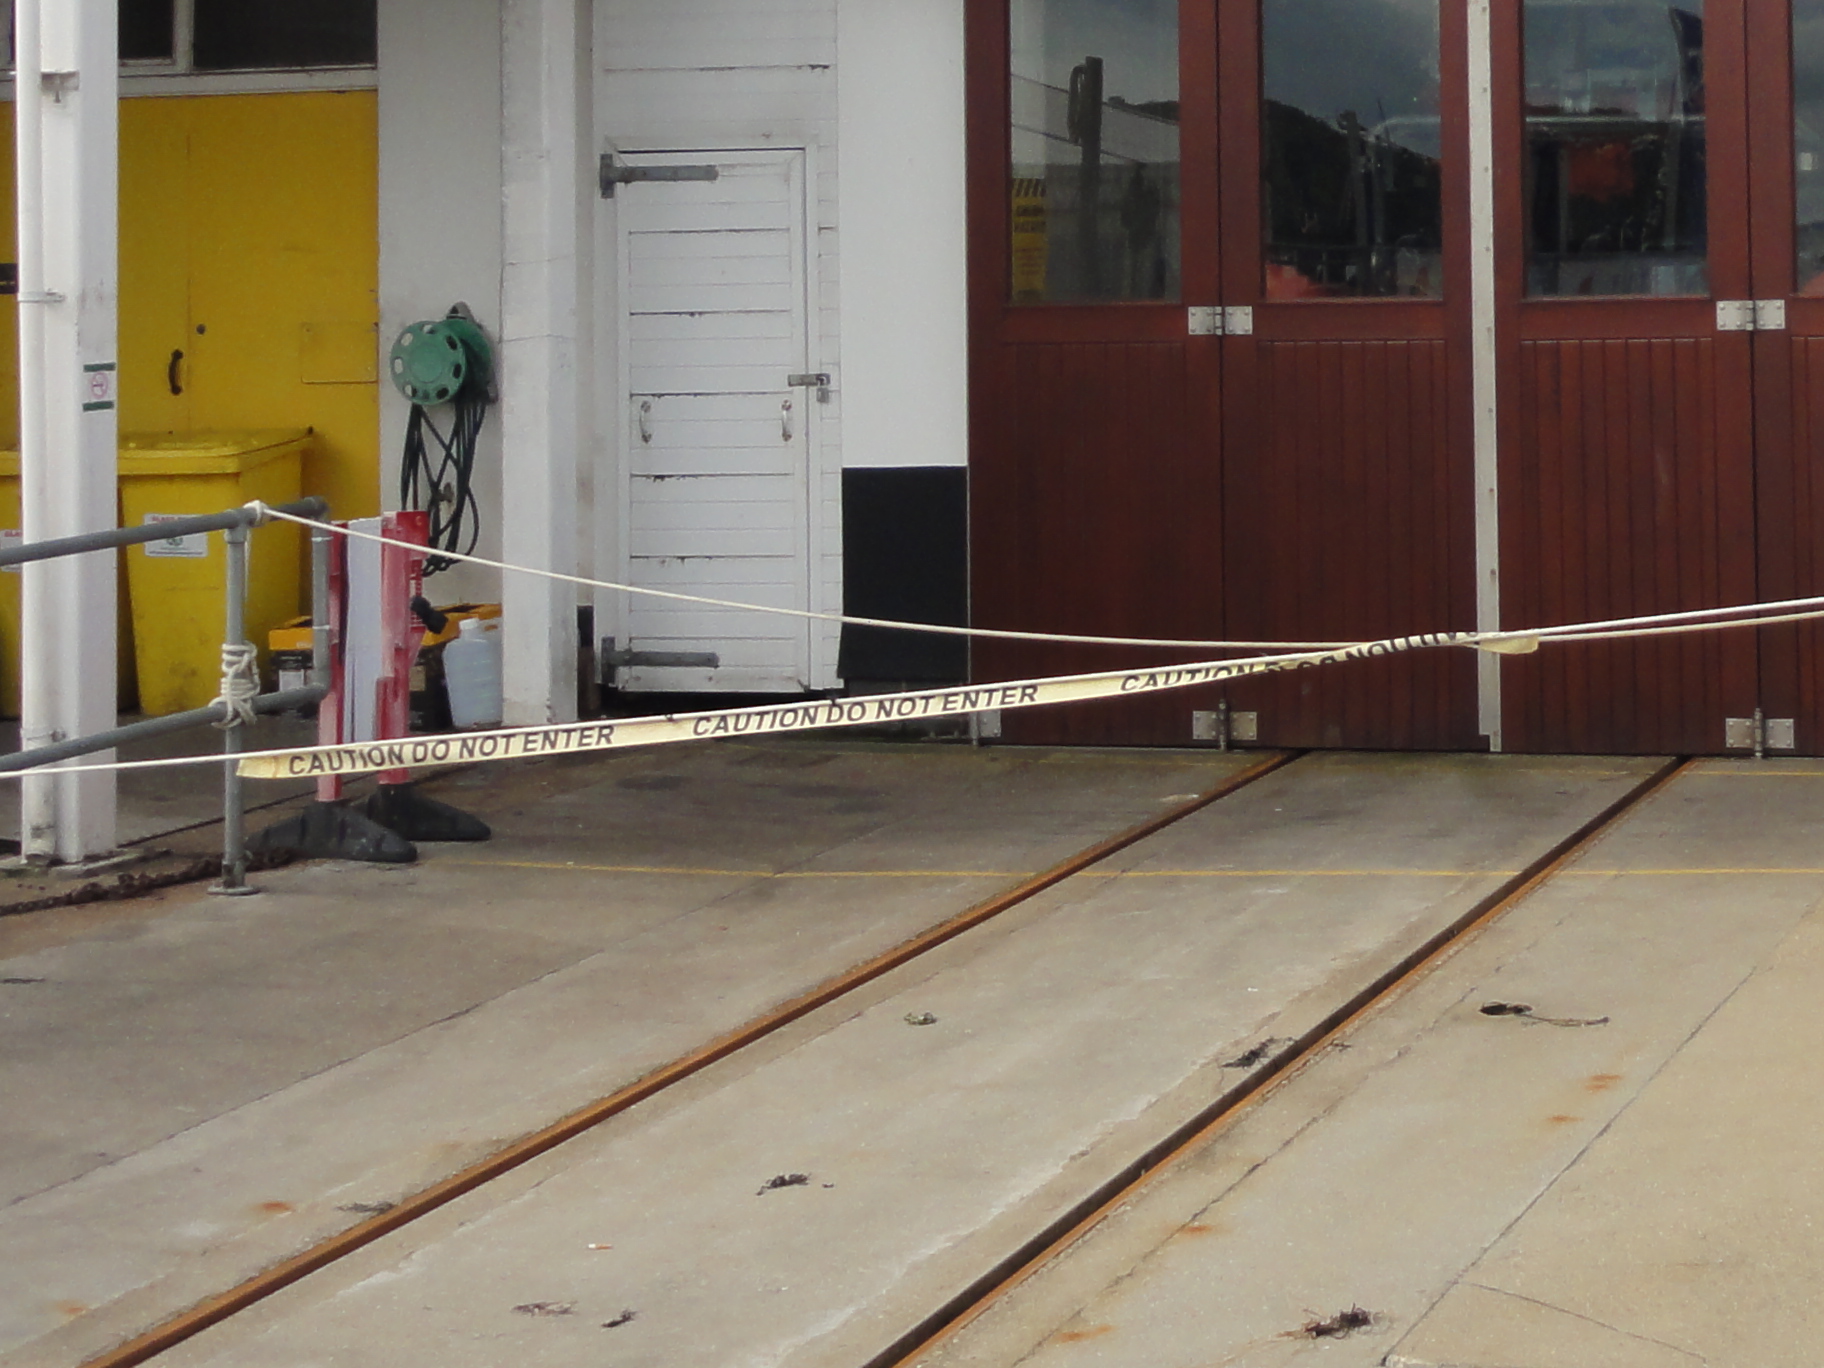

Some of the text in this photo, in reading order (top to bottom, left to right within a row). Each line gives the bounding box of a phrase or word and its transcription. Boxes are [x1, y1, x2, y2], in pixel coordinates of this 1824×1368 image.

[693, 685, 1038, 736] CAUTION DO NOT ENTER
[289, 726, 615, 775] CAUTION DO NOT ENTER
